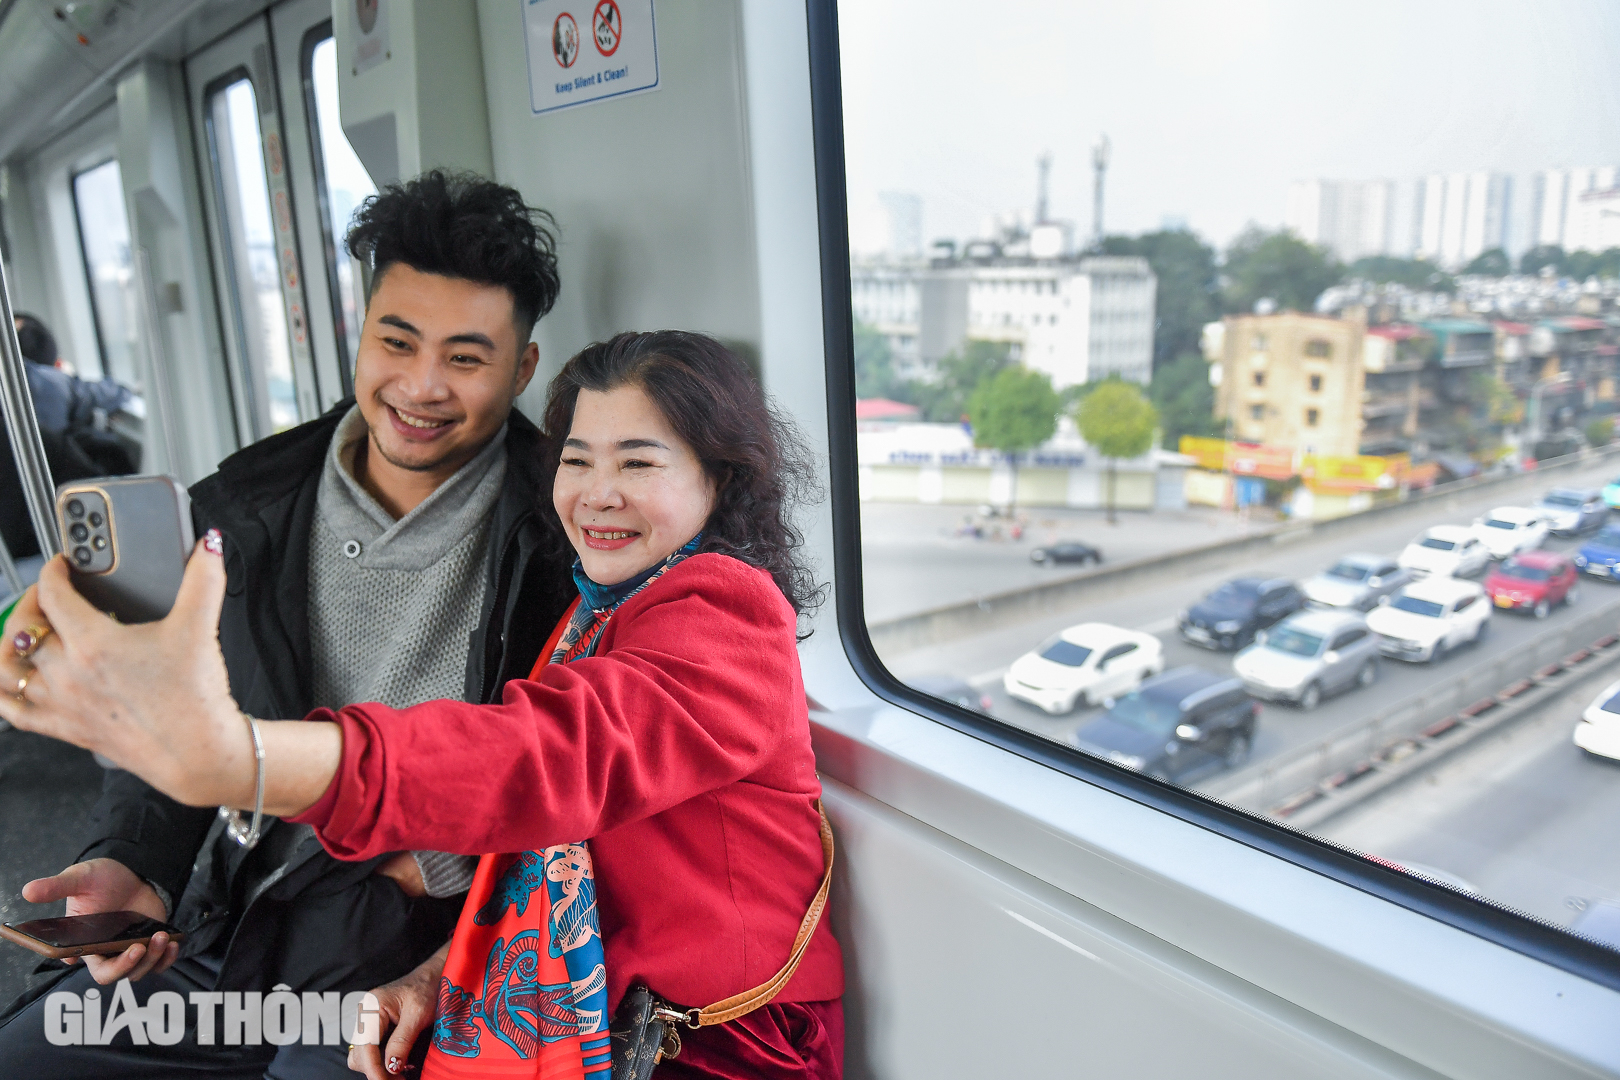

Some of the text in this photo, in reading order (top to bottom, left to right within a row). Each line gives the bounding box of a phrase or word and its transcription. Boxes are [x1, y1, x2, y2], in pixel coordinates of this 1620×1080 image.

[555, 65, 629, 94] Keep Silent & Clean!
